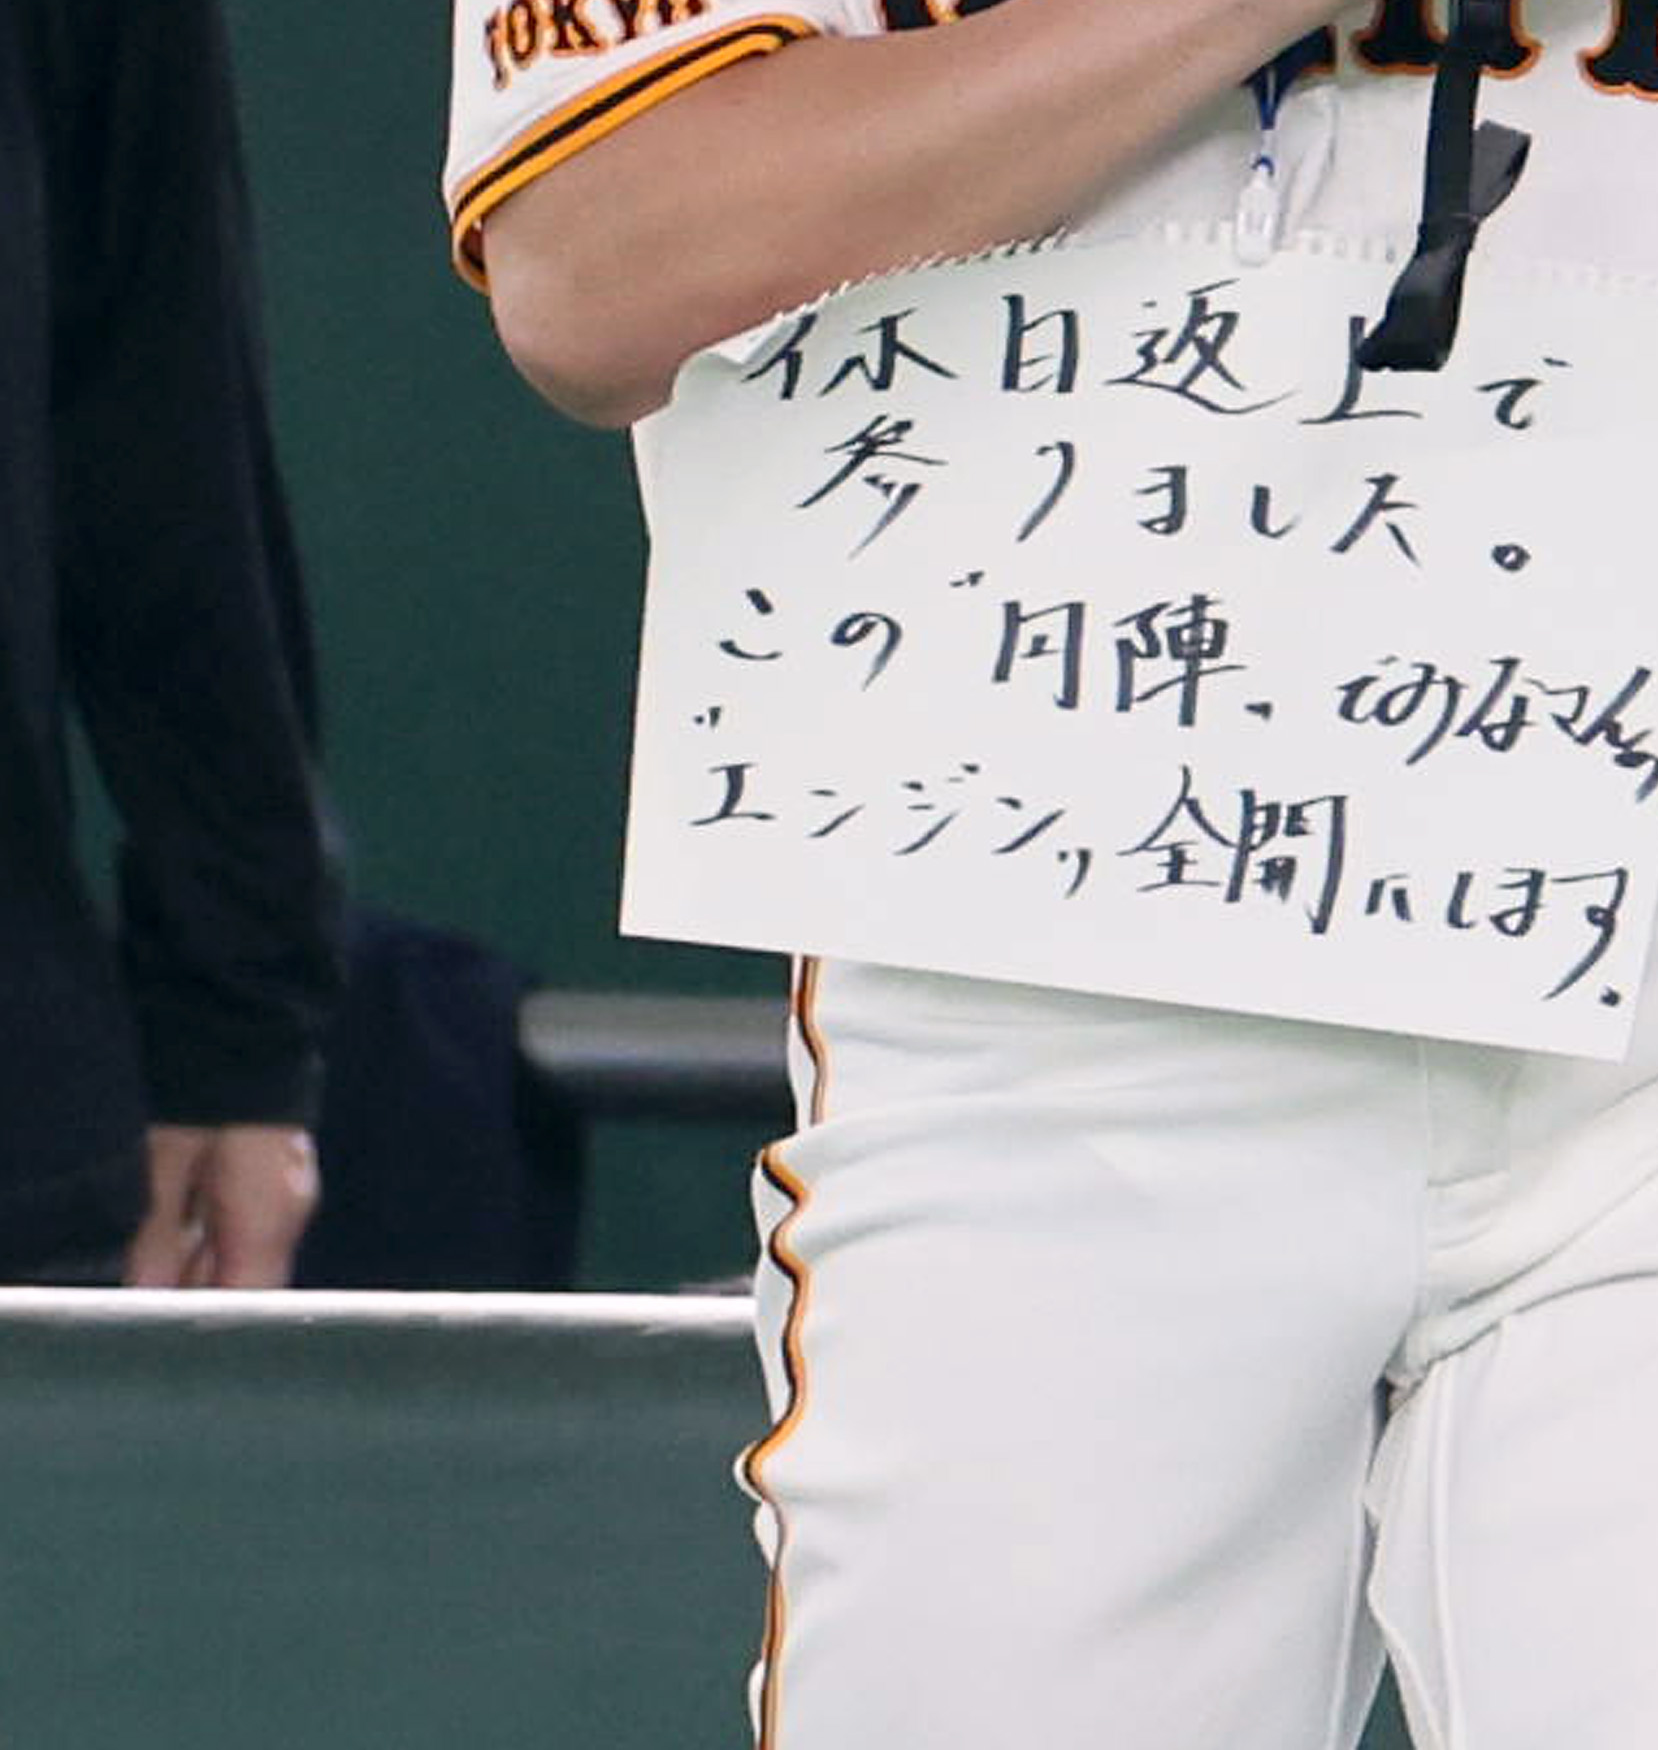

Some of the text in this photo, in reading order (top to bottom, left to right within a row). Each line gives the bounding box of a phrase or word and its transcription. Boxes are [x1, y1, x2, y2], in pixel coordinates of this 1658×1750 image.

[740, 278, 1573, 431] 休日返上で
[796, 413, 1532, 572] 参りました。
